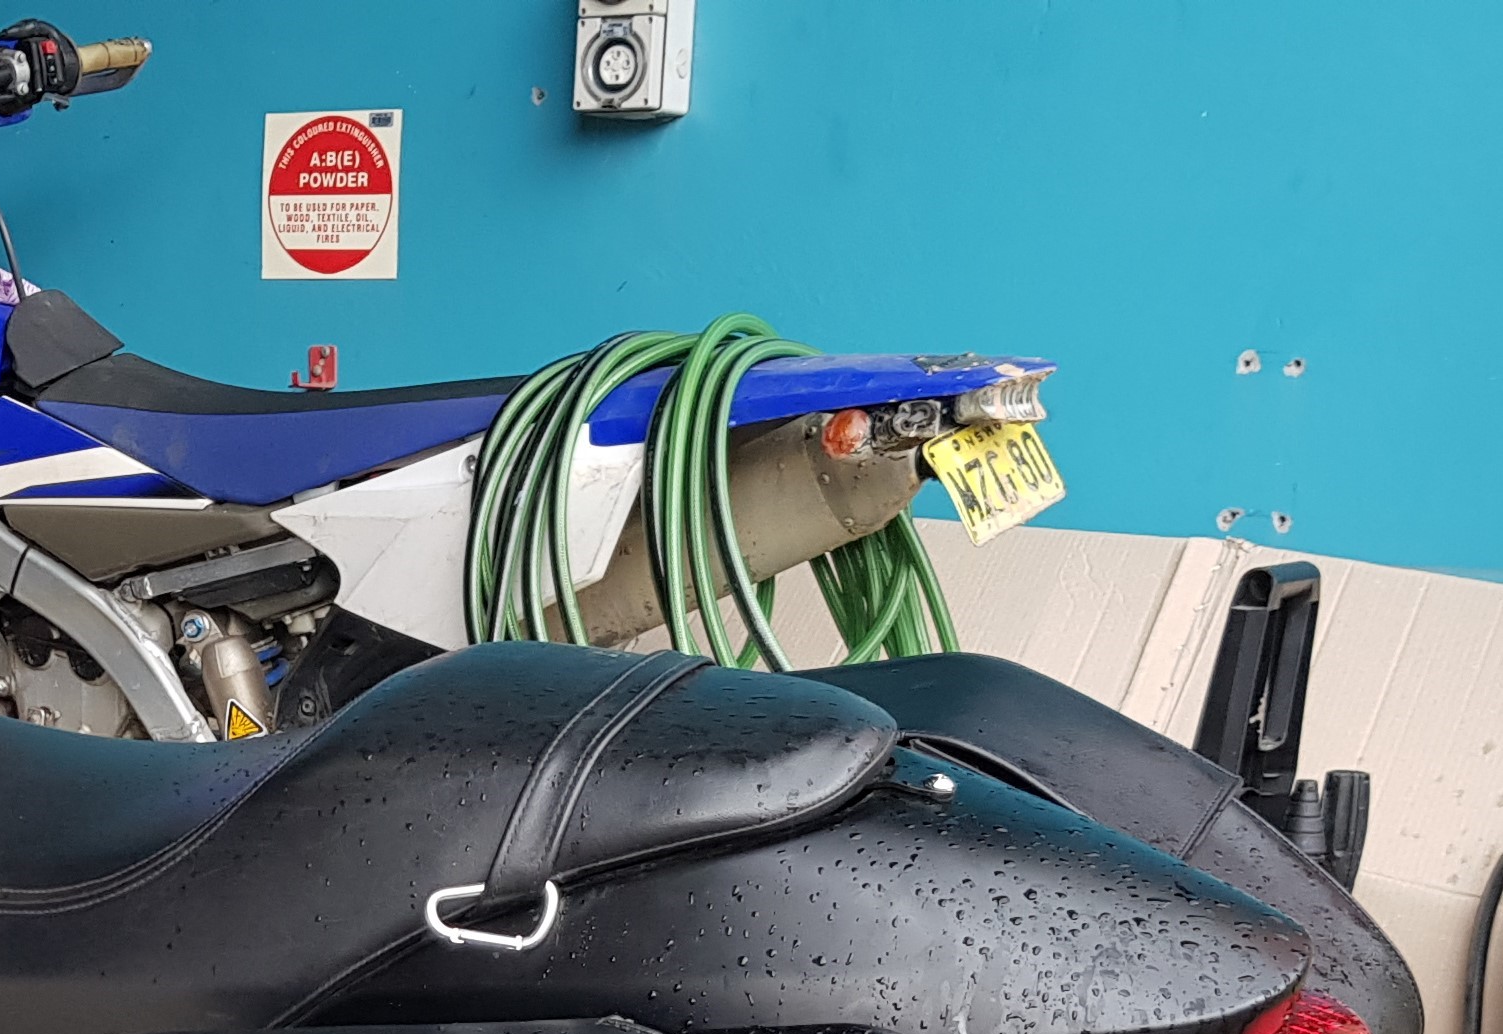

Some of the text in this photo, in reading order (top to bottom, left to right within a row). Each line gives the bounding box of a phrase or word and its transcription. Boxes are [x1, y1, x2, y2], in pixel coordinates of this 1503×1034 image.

[278, 121, 385, 169] THIS COLOURED EXTINGUISHER
[310, 150, 360, 170] A:B(E)
[299, 172, 369, 188] POWDER
[280, 203, 290, 212] TO
[293, 203, 302, 212] BE
[306, 202, 327, 212] USED
[330, 202, 347, 212] FOR
[311, 224, 328, 233] AND
[331, 223, 380, 233] ELECTRICAL
[316, 234, 340, 243] FIRES
